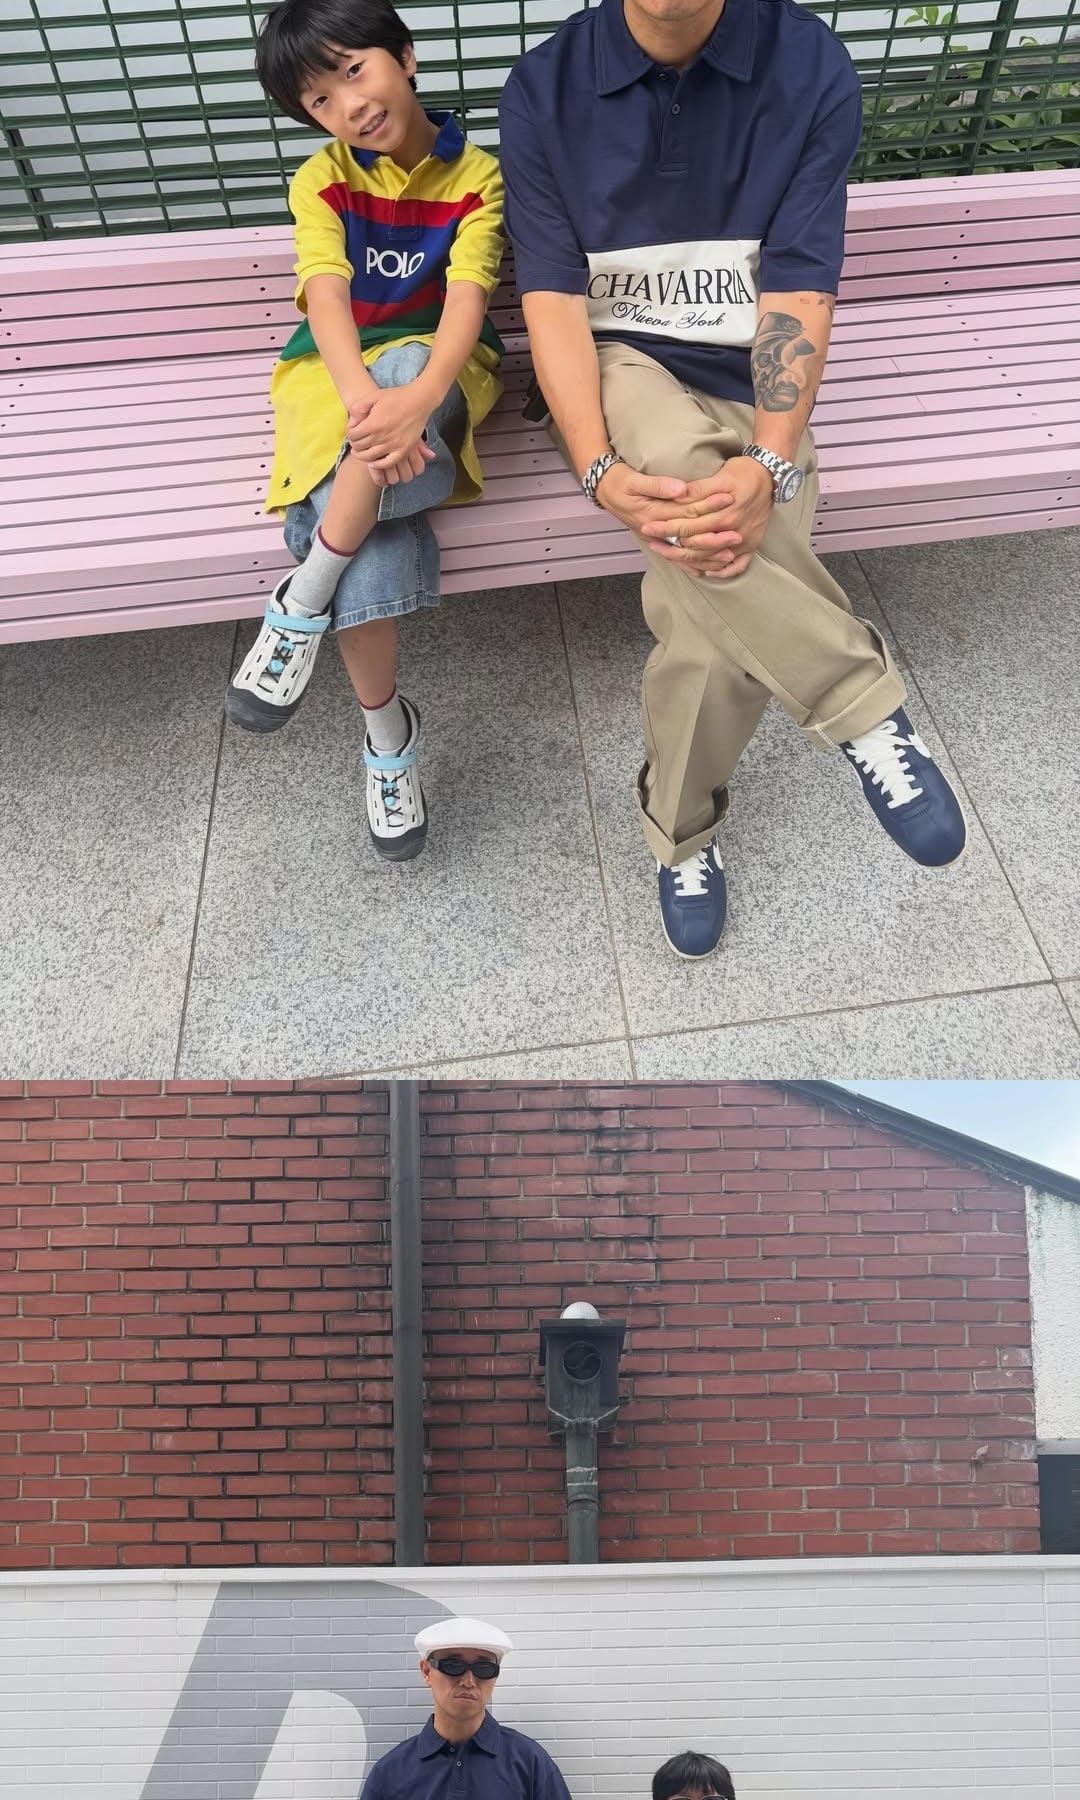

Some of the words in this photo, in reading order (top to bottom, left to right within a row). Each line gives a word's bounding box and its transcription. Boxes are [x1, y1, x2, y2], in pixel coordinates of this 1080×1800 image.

[366, 246, 425, 279] POLO
[611, 301, 673, 327] Nueva
[675, 310, 729, 329] York
